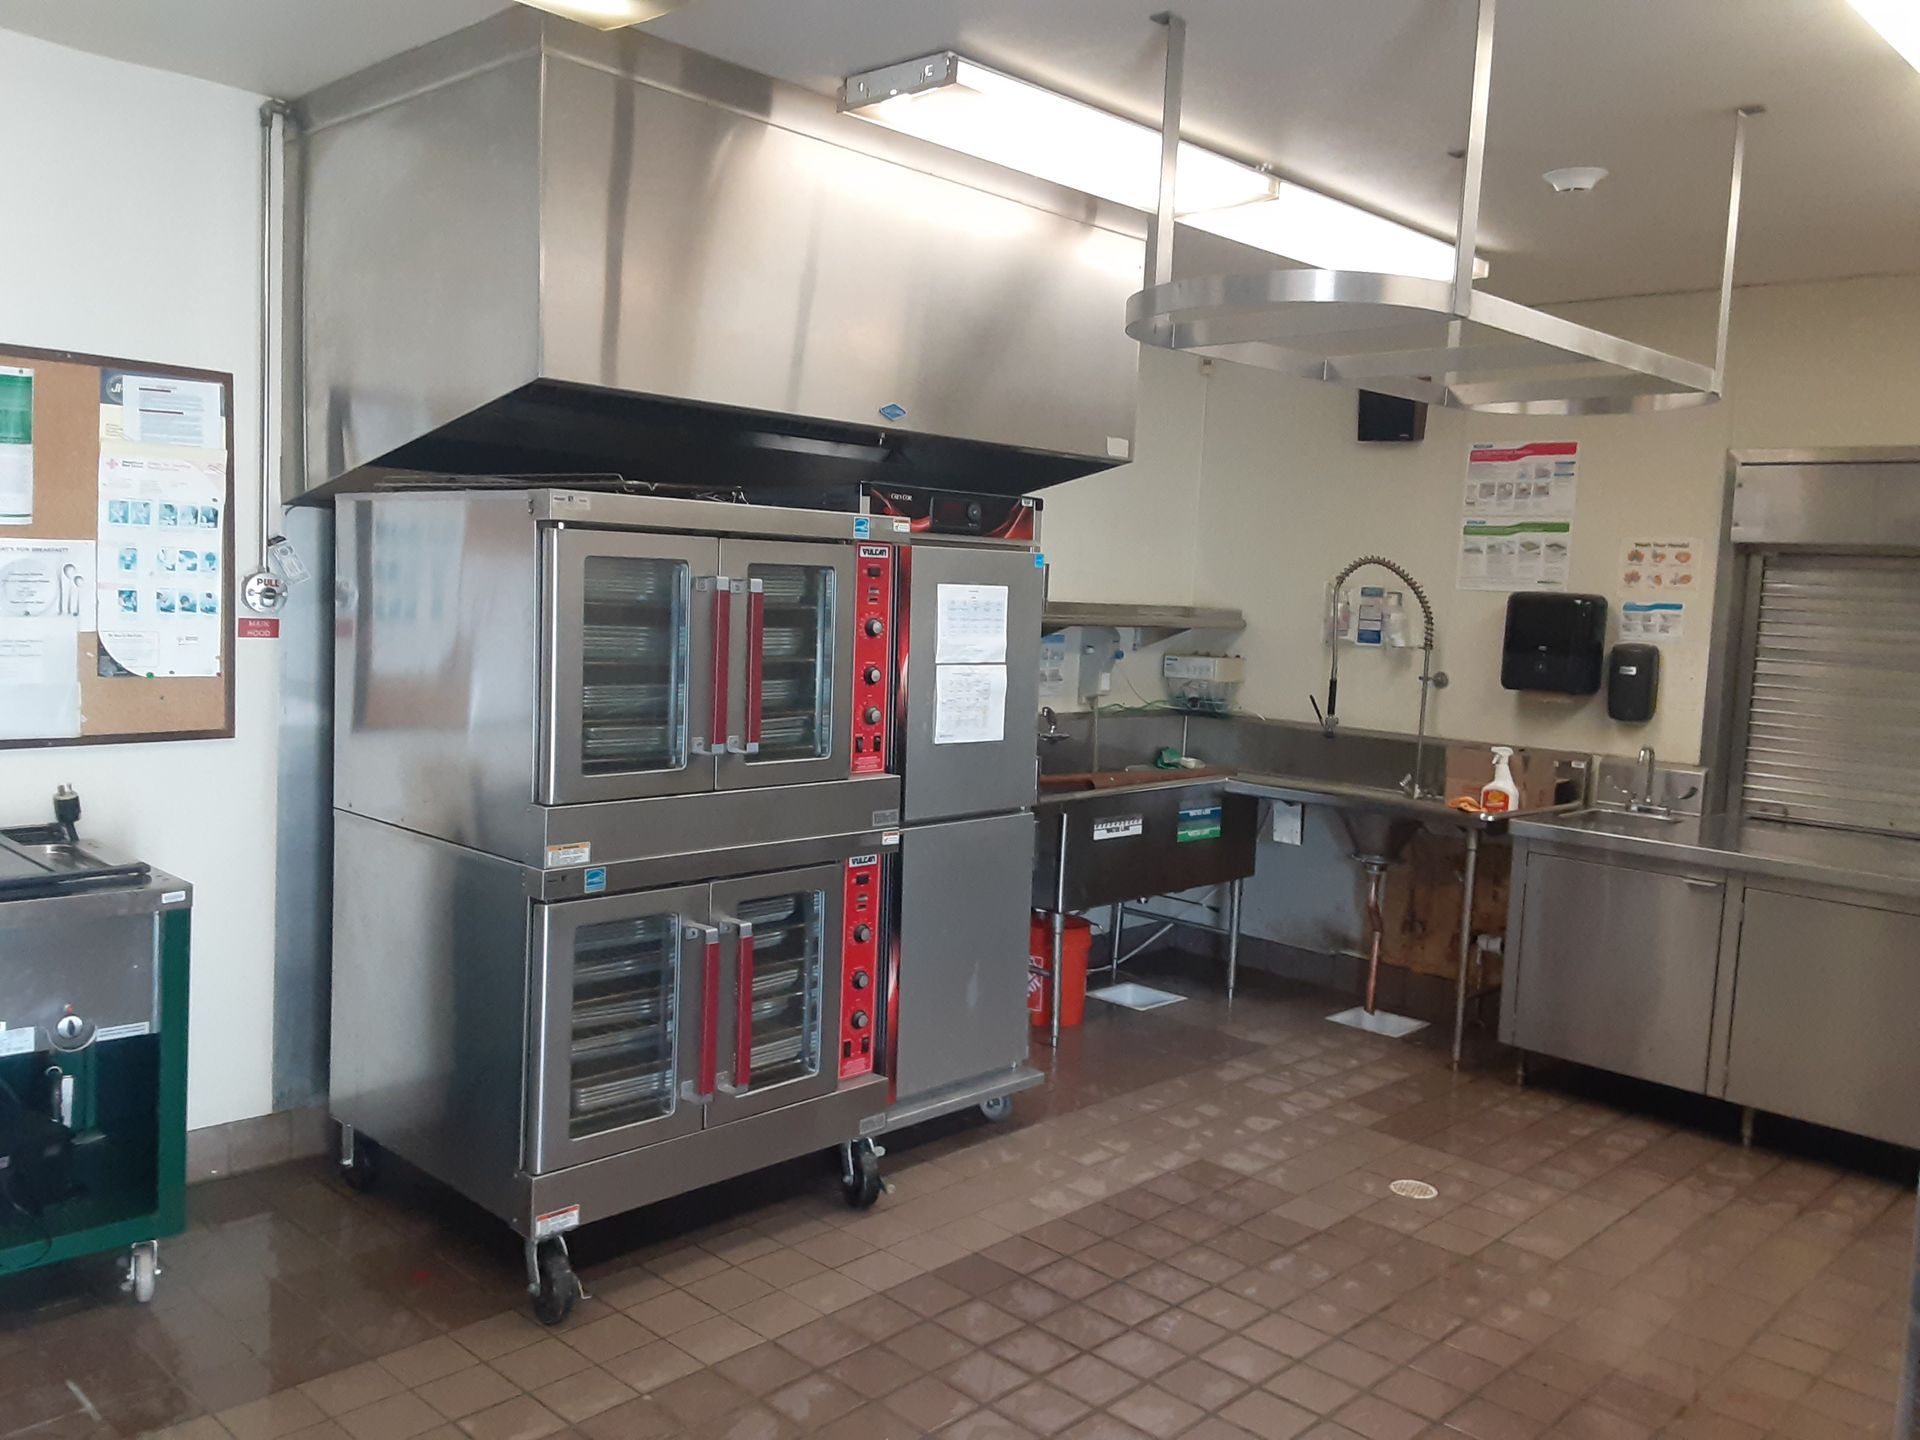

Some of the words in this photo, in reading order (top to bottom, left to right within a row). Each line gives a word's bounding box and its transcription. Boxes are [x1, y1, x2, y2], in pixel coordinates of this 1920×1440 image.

[862, 547, 888, 557] VULCAN
[257, 578, 280, 587] PULL
[851, 855, 876, 865] VULCAN
